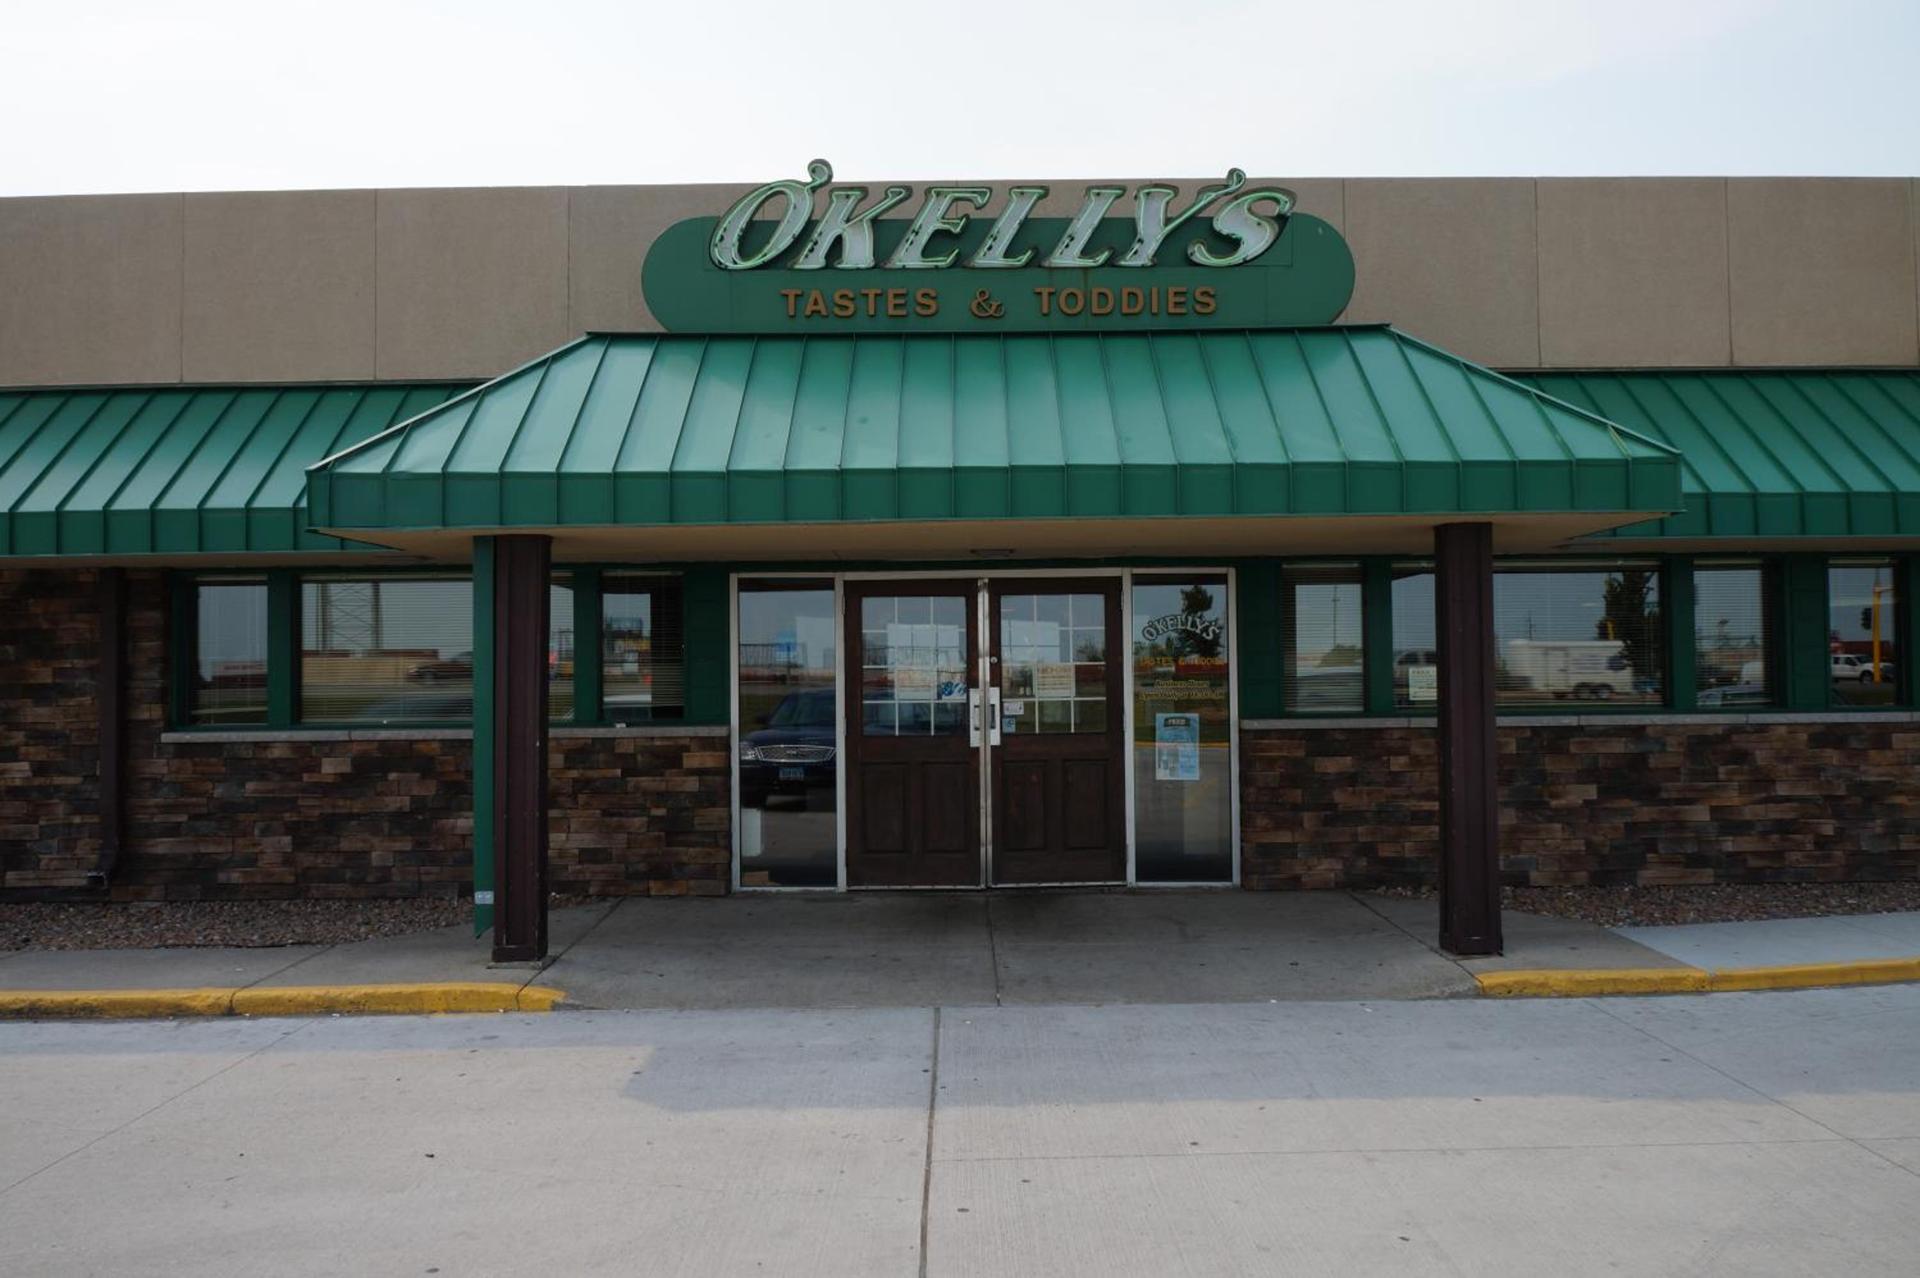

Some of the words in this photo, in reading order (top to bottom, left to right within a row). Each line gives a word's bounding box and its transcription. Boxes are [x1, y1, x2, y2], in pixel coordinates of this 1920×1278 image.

[708, 158, 1297, 271] O'KELLY'S
[780, 286, 939, 319] TASTES
[970, 287, 1006, 318] &
[1034, 285, 1219, 316] TODDIES
[1142, 613, 1220, 641] O'KELLY'S
